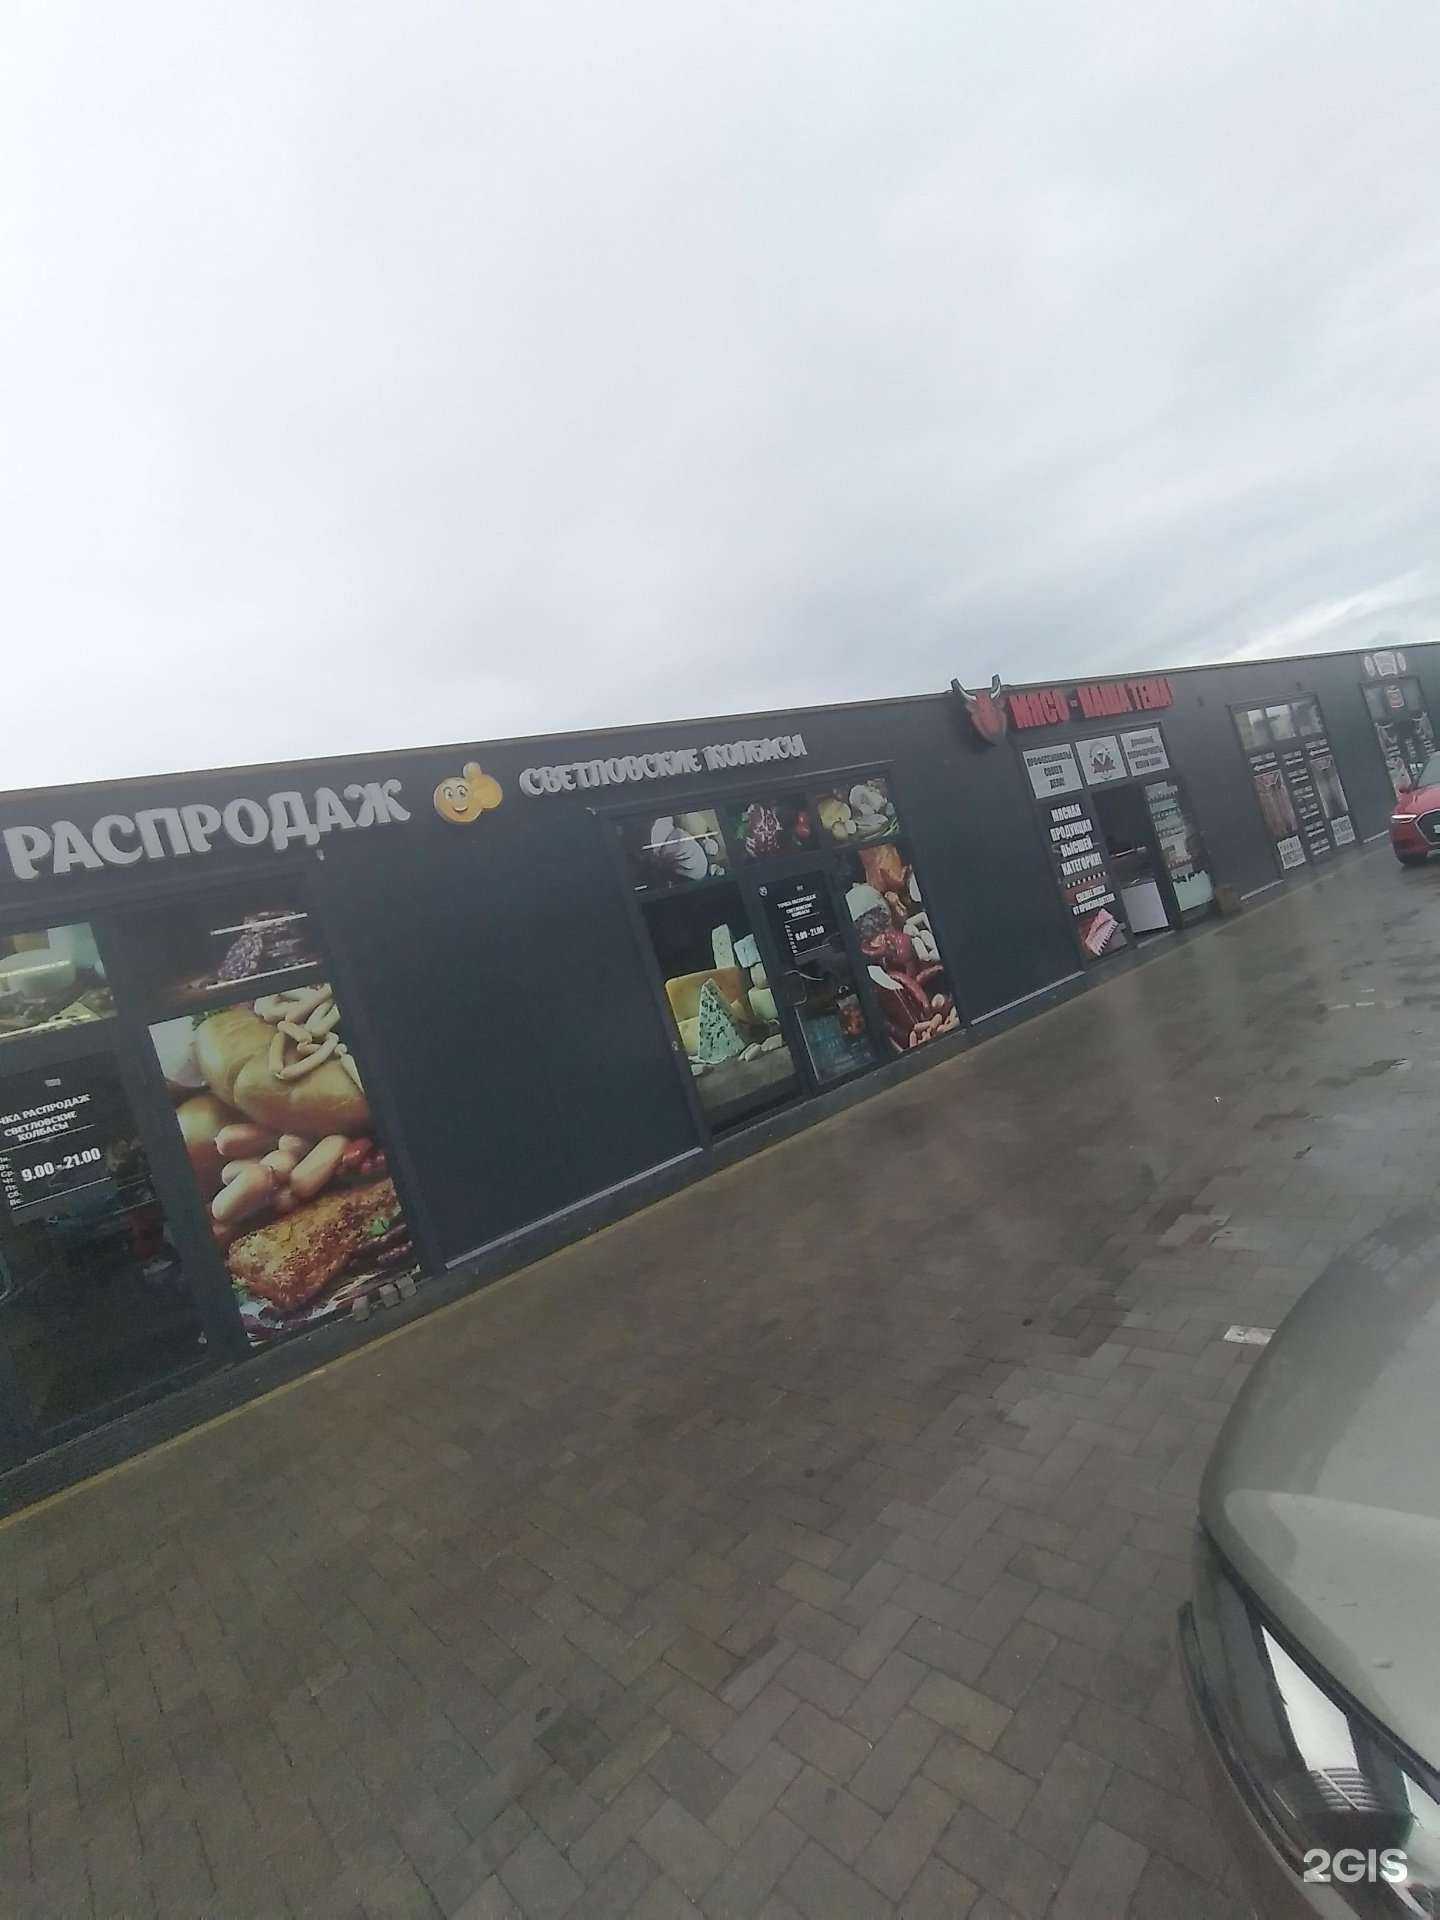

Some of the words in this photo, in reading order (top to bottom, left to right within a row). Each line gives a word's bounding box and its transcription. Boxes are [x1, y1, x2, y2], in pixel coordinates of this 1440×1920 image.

[519, 748, 702, 796] СВЕТЛОВСКИЕ
[702, 734, 808, 771] КОЛБАСЫ
[2, 778, 411, 880] РАСПРОДАЖ
[22, 1093, 91, 1119] РАСПРОДАЖ
[4, 1110, 78, 1137] СВЕТЛОВСКИЕ
[18, 1121, 69, 1141] КОЛБАСЫ
[21, 1161, 55, 1182] 9.00
[62, 1147, 101, 1169] 21.00
